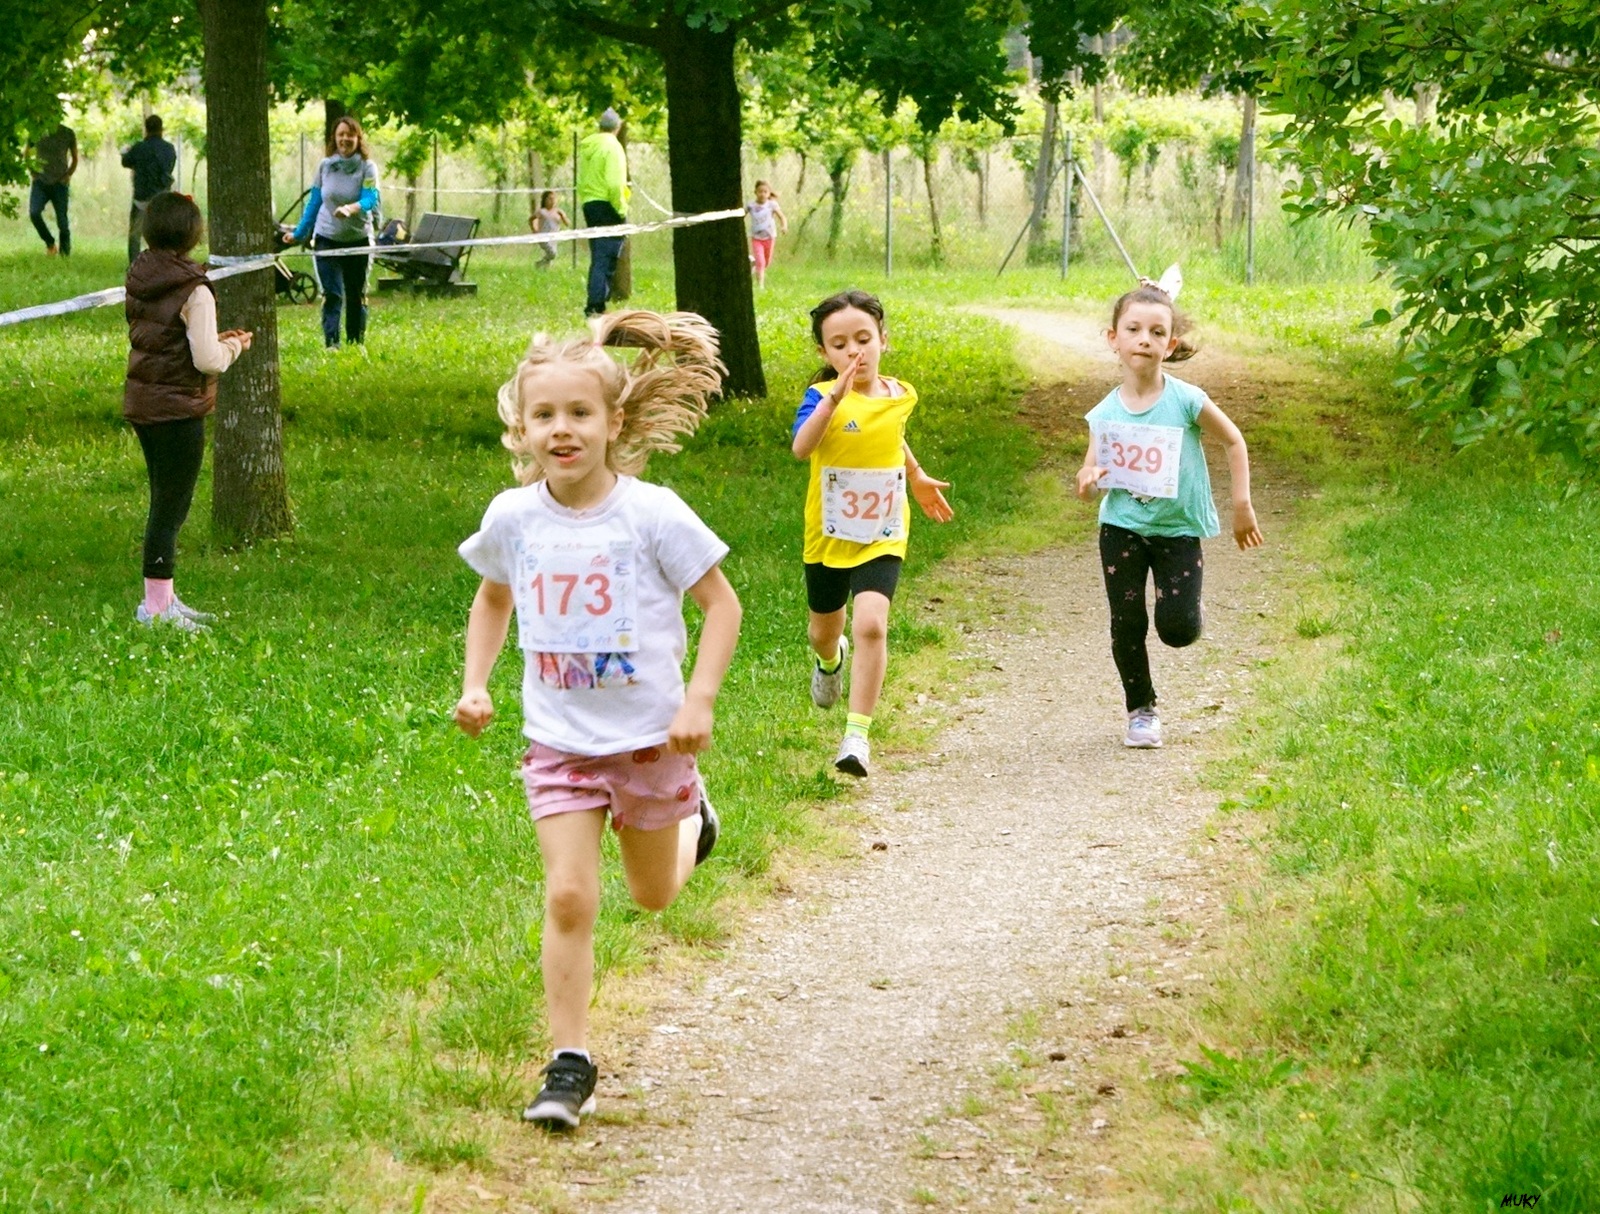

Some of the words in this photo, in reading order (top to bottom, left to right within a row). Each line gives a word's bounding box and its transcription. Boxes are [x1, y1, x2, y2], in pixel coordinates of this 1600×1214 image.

[1111, 441, 1163, 475] 329
[841, 490, 894, 520] 321
[530, 572, 613, 616] 173
